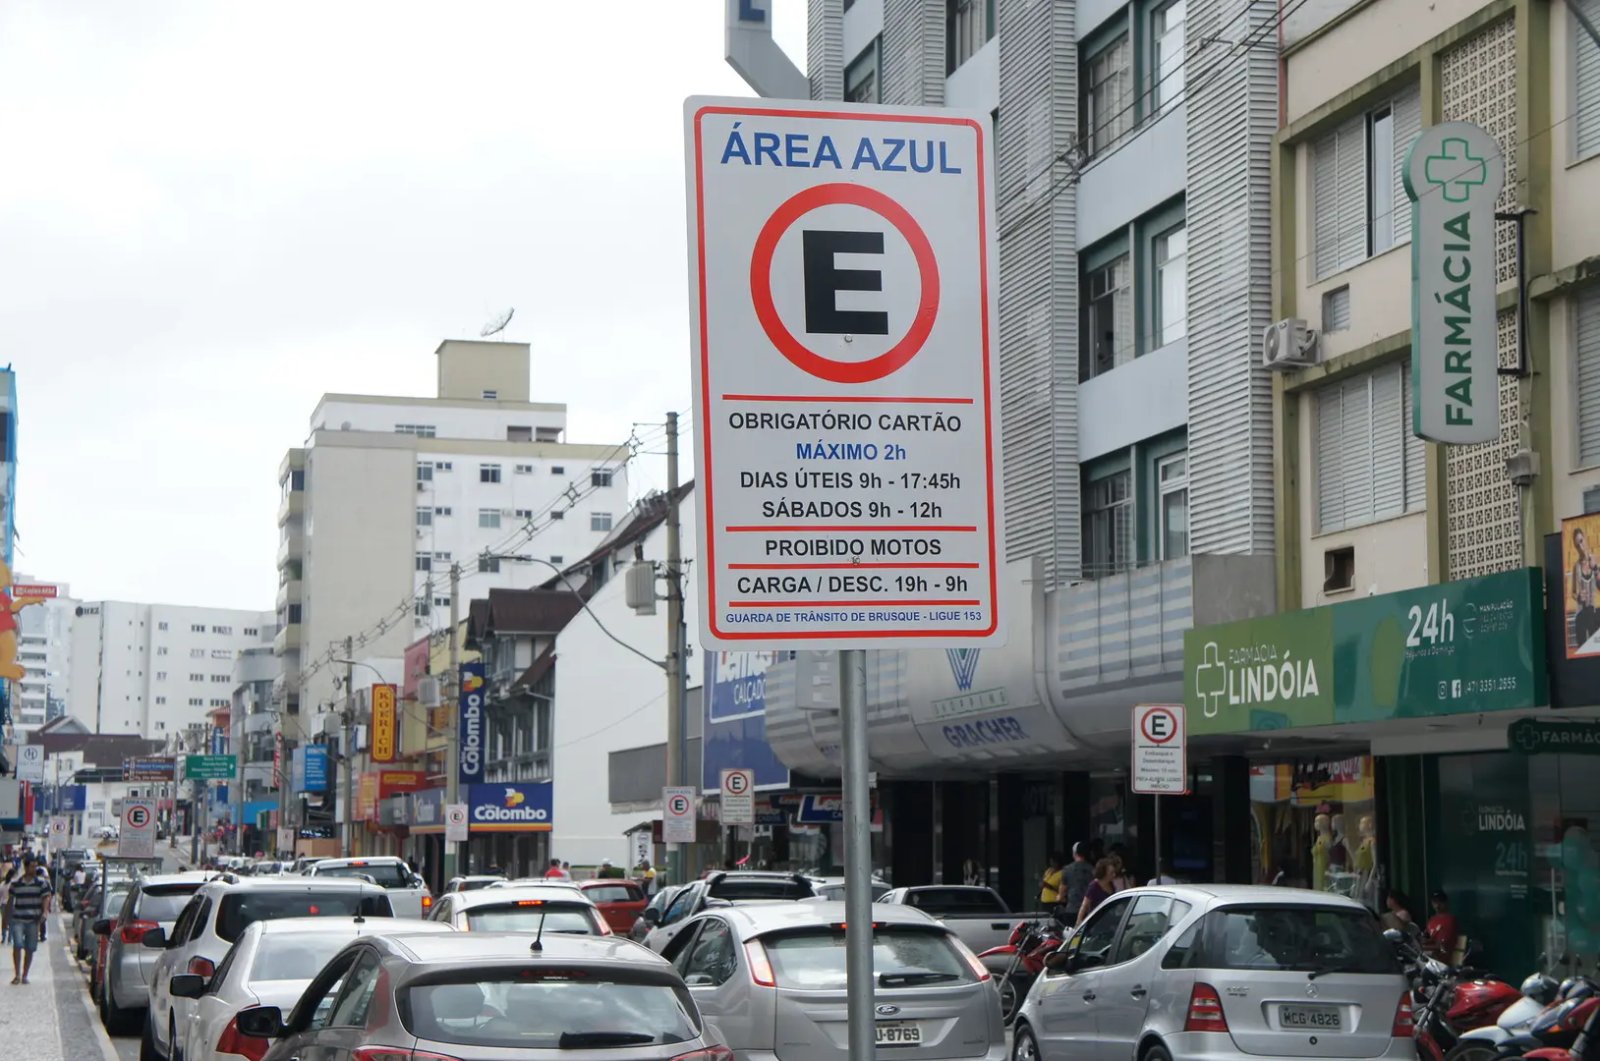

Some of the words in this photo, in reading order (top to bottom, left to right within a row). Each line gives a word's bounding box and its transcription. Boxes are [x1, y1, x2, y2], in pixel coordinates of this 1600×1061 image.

[720, 121, 843, 170] ÁREA
[851, 136, 962, 175] AZUL
[803, 229, 889, 335] E
[1434, 210, 1473, 426] FARMÁCIA
[728, 409, 872, 431] OBRIGATÓRIO
[878, 411, 962, 432] CARTÃO
[796, 439, 878, 461] MÁXIMO
[884, 444, 906, 460] 2h
[740, 471, 788, 489] DIAS
[795, 467, 853, 489] ÚTEIS
[859, 472, 882, 489] 9h
[900, 472, 961, 489] 17:45h
[762, 497, 863, 518] SÁBADOS
[868, 501, 891, 518] 9h
[909, 501, 942, 518] 12h
[765, 538, 865, 556] PROIBIDO
[871, 538, 942, 556] MOTOS
[737, 576, 812, 594] CARGA
[816, 576, 823, 593] /
[828, 576, 889, 593] DESC.
[895, 576, 928, 592] 19h
[945, 576, 968, 592] 9h
[726, 612, 774, 623] GUARDA
[776, 612, 791, 623] DE
[793, 610, 849, 622] TRÂNSITO
[851, 612, 866, 622] DE
[868, 611, 920, 623] BRUSQUE
[929, 611, 961, 622] LIGUE
[964, 611, 982, 621] 153
[1406, 598, 1455, 647] 24h
[1229, 643, 1277, 664] FARMÁCIA
[1229, 649, 1319, 705] LINDÓIA
[378, 691, 390, 755] KOERICH
[943, 716, 1030, 748] GRACHER
[1152, 715, 1167, 736] E
[463, 694, 481, 775] Colombo
[732, 776, 742, 790] E
[474, 804, 547, 820] Colombo
[675, 799, 684, 811] E
[134, 811, 144, 823] E
[1479, 809, 1526, 831] LINDÓIA
[1496, 841, 1528, 869] 24h
